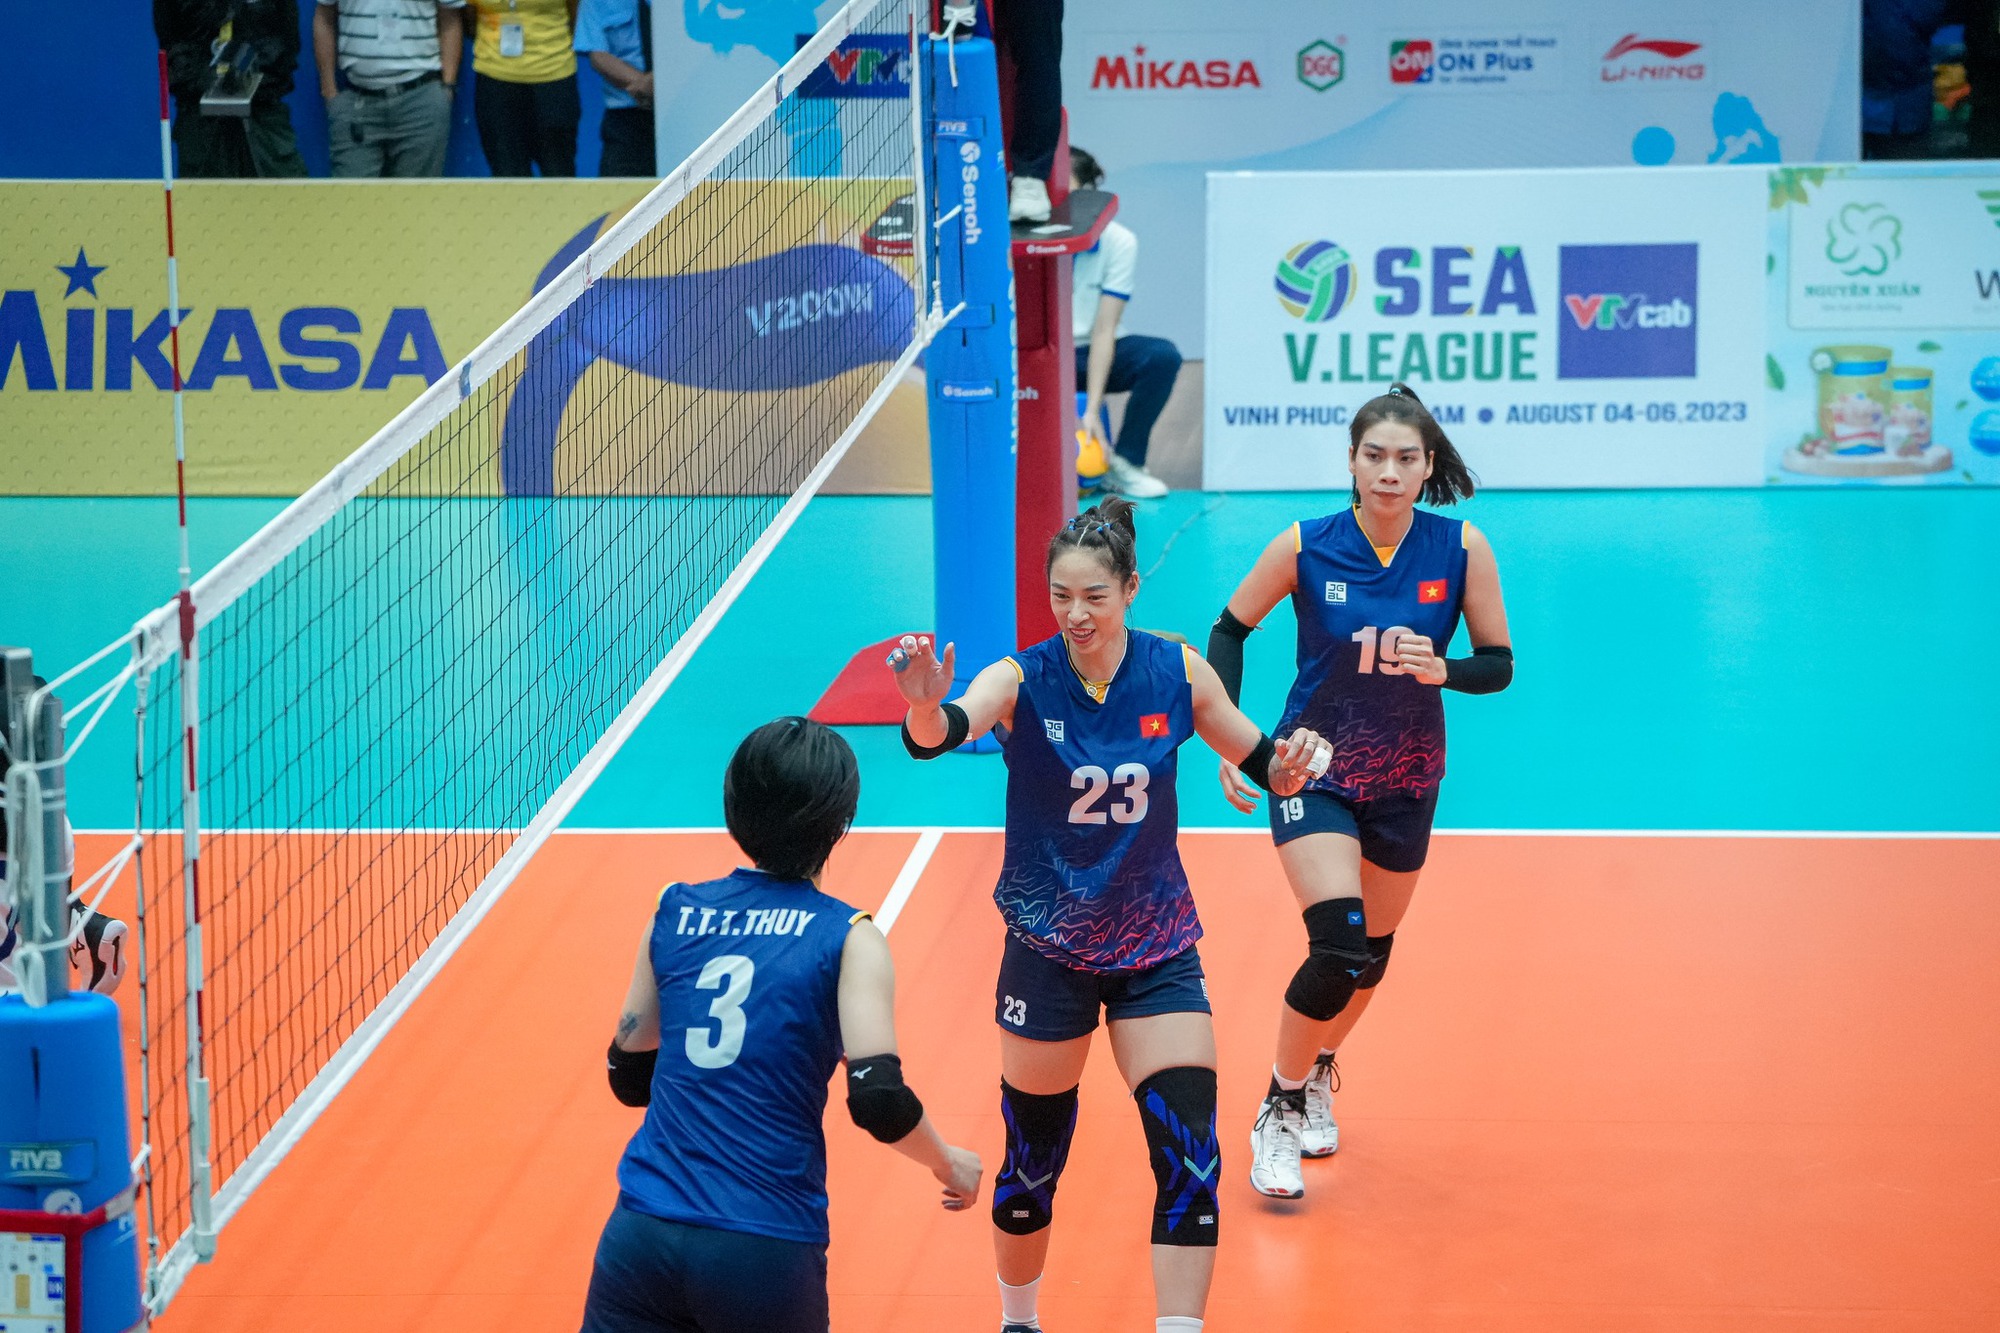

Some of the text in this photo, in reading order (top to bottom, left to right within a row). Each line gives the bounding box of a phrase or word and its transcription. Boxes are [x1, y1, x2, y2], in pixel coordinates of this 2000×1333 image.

[1302, 55, 1340, 77] DGC
[1438, 53, 1534, 71] ON Plus
[962, 164, 983, 244] Senoh
[1374, 246, 1537, 317] SEA
[1565, 294, 1692, 330] VTVcab
[1284, 332, 1538, 382] V.LEAGUE
[1223, 405, 1279, 426] VINH
[1506, 403, 1597, 423] AUGUST
[1068, 762, 1150, 825] 23
[1279, 797, 1305, 825] 19
[676, 906, 816, 937] T.T.T.THUY
[685, 954, 755, 1069] 3
[1003, 995, 1028, 1027] 23
[10, 1150, 63, 1171] FIVB
